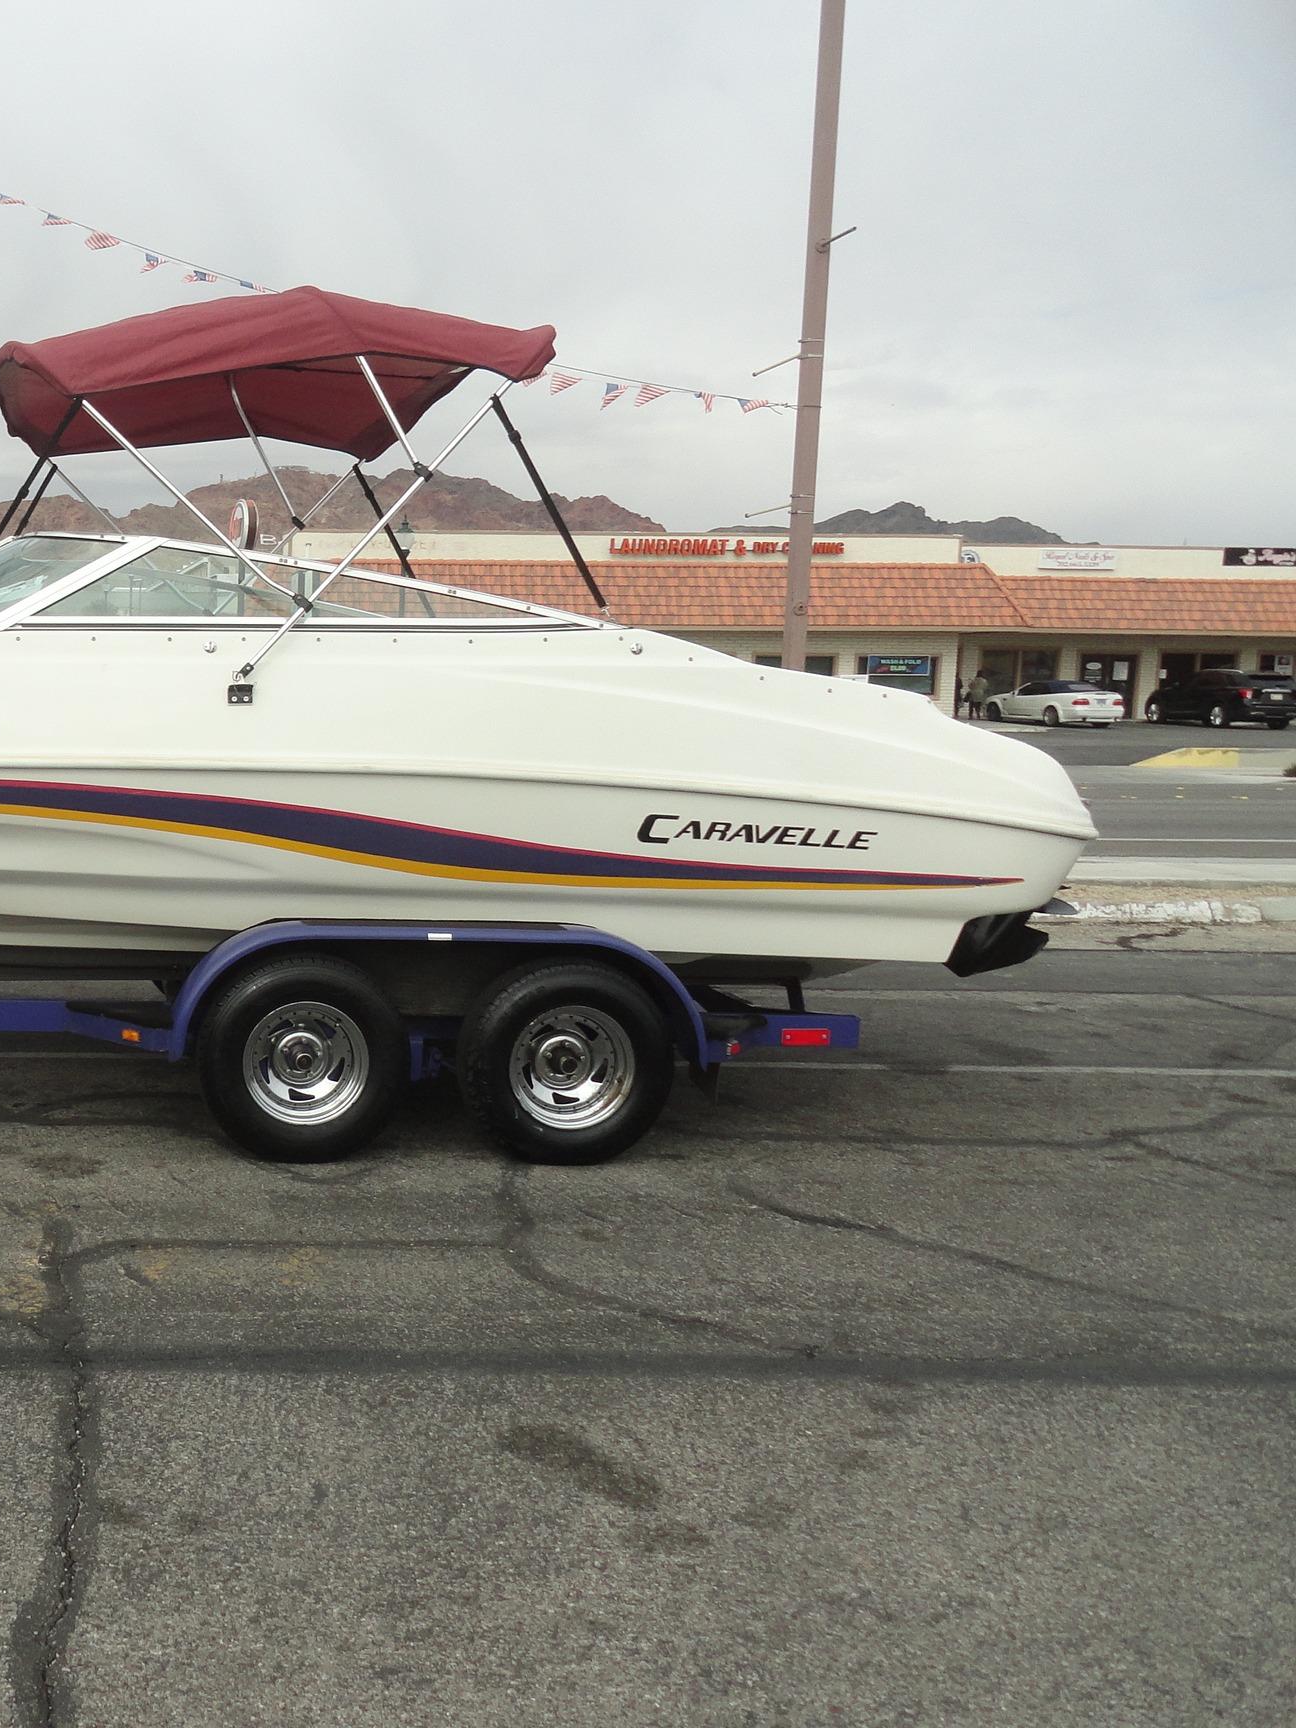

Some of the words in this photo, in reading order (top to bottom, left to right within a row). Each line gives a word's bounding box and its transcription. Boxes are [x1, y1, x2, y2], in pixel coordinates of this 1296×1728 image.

[609, 538, 729, 555] LAUNDROMAT
[734, 539, 747, 557] &
[752, 541, 779, 554] DRY
[781, 541, 845, 555] CNING
[637, 814, 878, 850] CARAVELLE
